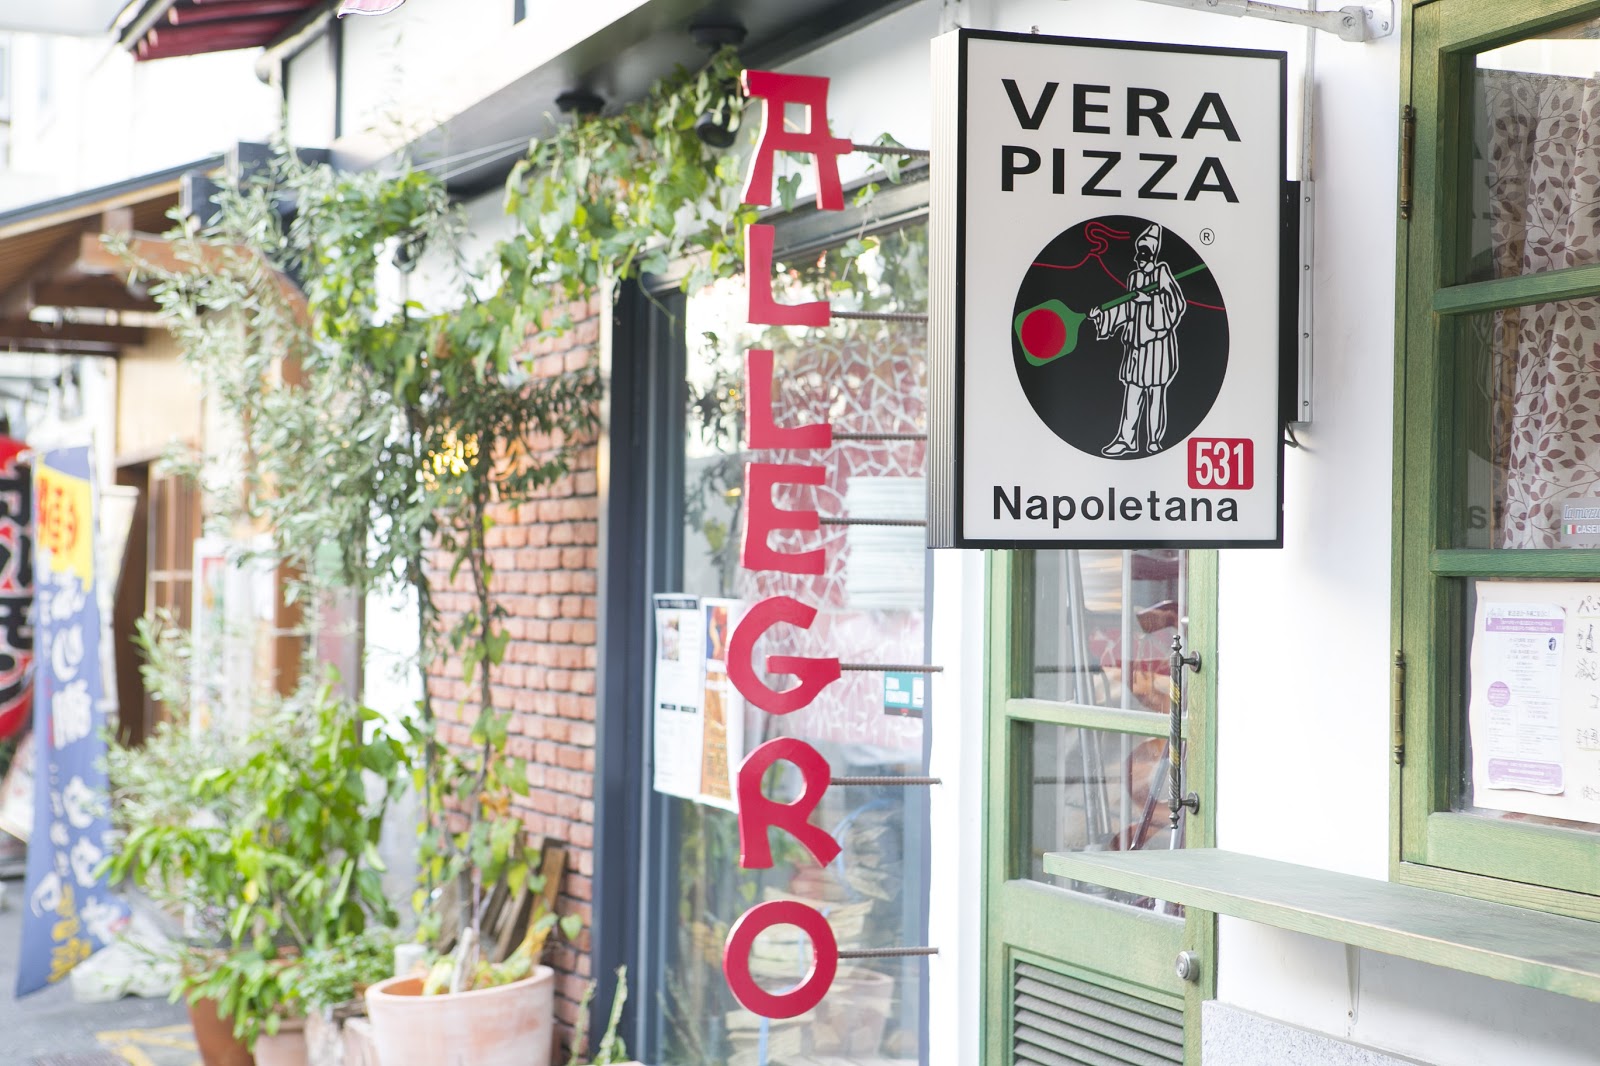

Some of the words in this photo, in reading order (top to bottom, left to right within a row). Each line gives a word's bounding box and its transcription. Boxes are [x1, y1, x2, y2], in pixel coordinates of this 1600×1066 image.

[1001, 78, 1242, 143] VERA
[1001, 145, 1240, 204] PIZZA
[1195, 441, 1244, 486] 531
[993, 485, 1239, 529] Napoletana
[723, 69, 852, 1019] ALLEGRO
